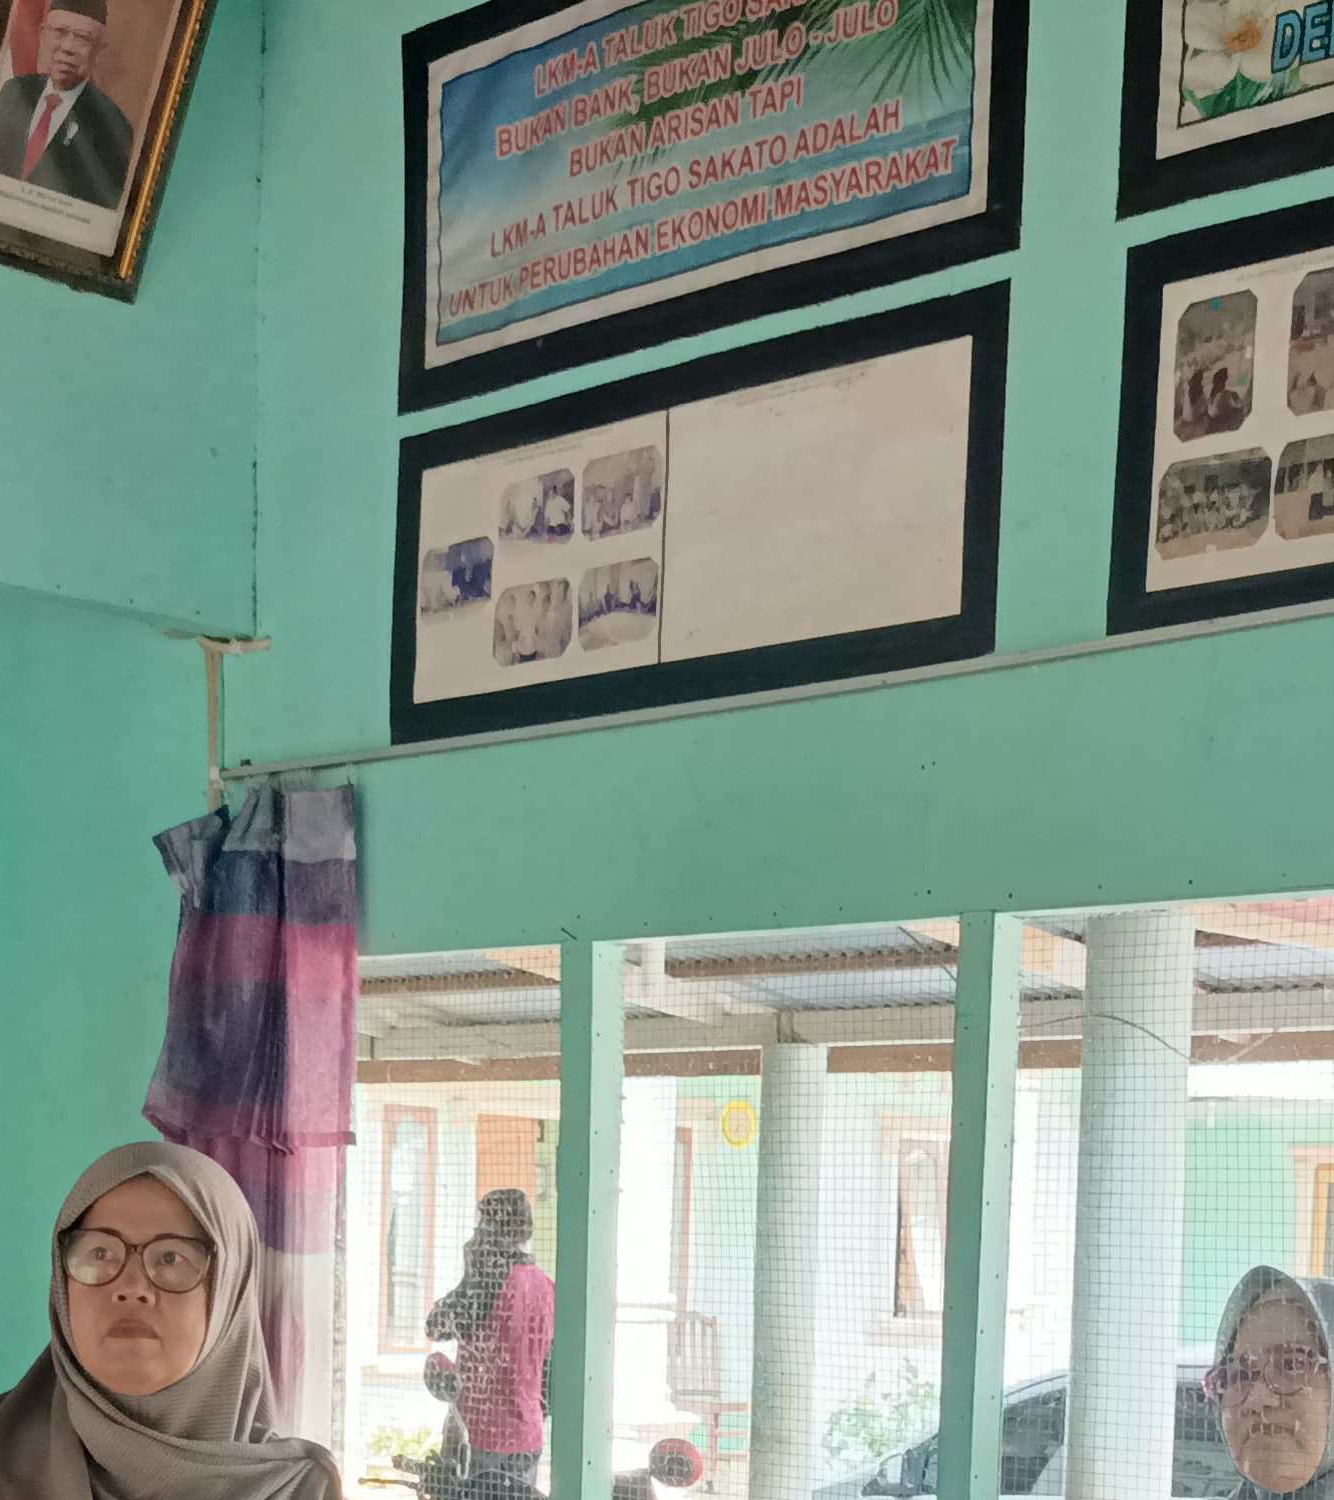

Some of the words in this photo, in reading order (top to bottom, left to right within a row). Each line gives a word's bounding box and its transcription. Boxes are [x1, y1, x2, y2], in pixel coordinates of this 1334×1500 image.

[497, 104, 566, 157] BUKAN
[573, 79, 639, 127] BANK,
[645, 45, 732, 100] BUKAN
[736, 23, 806, 73] JULO
[826, 0, 897, 43] JULO
[535, 45, 599, 96] LKM-A
[603, 11, 676, 65] TALUK
[682, 1, 741, 38] TIGO
[569, 124, 644, 177] BUKAN
[649, 93, 741, 148] ARISAN
[749, 77, 803, 119] TAPI
[448, 277, 514, 317] UNTUK
[518, 227, 650, 292] PERUBAHAN
[655, 191, 769, 251] EKONOMI
[774, 138, 958, 218] MASYARAKAT
[490, 212, 547, 258] LKM-A
[553, 186, 618, 232] TALUK
[627, 166, 681, 208] TIGO
[688, 135, 787, 189] SAKATO
[794, 99, 902, 159] ADALAH
